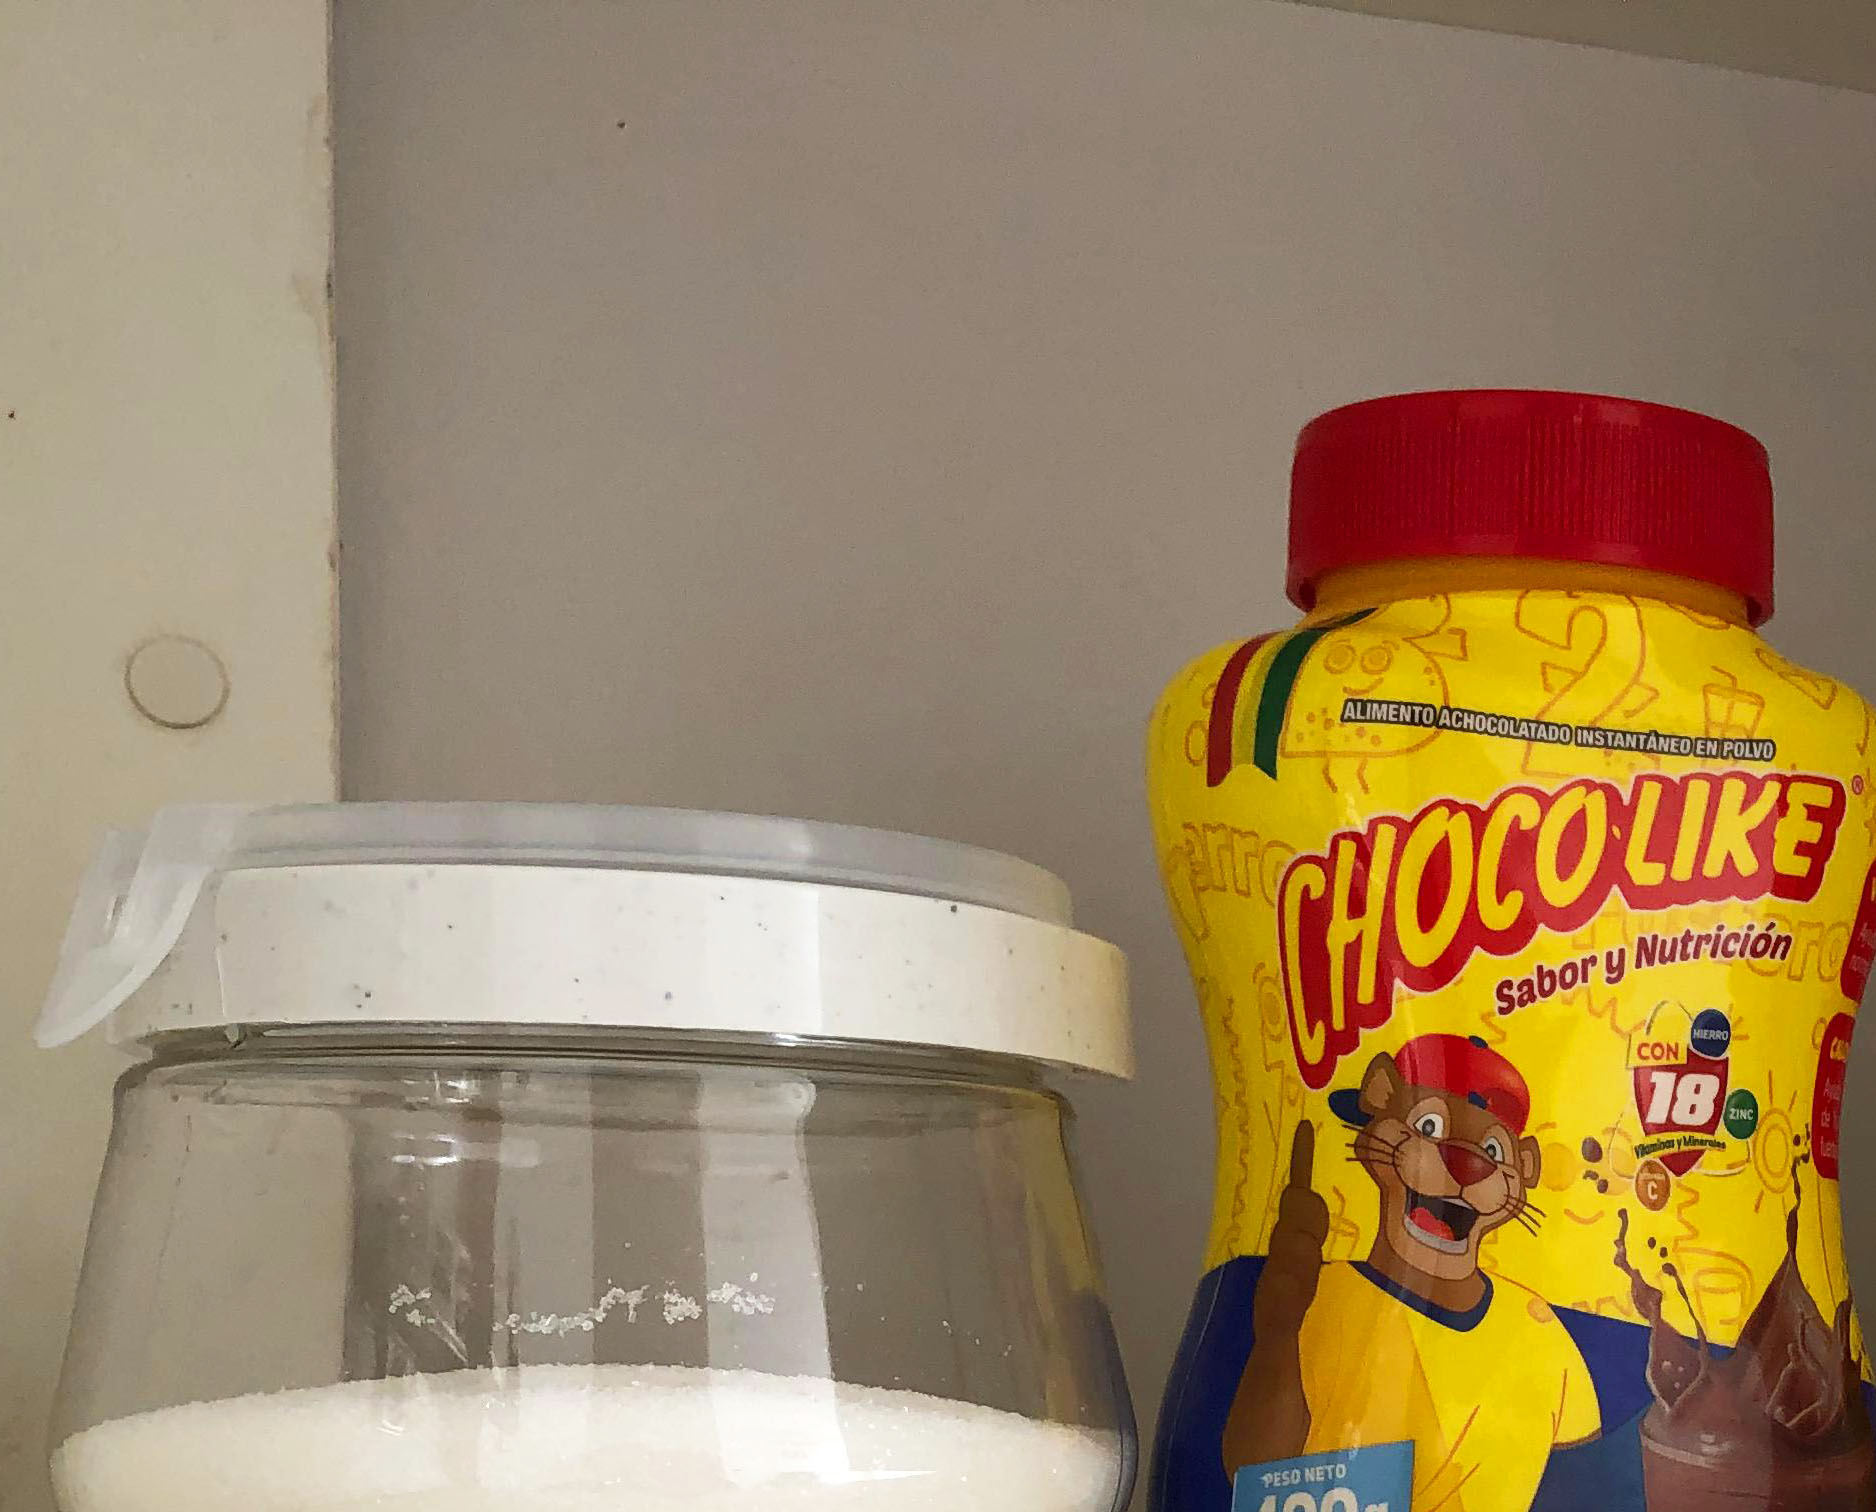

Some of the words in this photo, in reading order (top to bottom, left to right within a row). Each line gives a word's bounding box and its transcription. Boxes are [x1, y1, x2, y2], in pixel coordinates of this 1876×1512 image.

[1343, 700, 1434, 726] ALIMENTO
[1439, 710, 1571, 744] ACHOCOLATADO
[1576, 725, 1691, 755] INSTANTÁNEO
[1696, 740, 1718, 756] EN
[1722, 741, 1774, 761] POLVO
[1495, 954, 1597, 1016] Sabor
[1605, 947, 1625, 985] y
[1633, 921, 1794, 970] Nutrición
[1693, 1028, 1729, 1041] HIERRO
[1636, 1042, 1680, 1060] CON
[1645, 1071, 1720, 1126] 18
[1729, 1107, 1754, 1121] ZINC
[1647, 1181, 1658, 1200] C
[1264, 1468, 1301, 1488] PESO
[1304, 1463, 1347, 1483] NETO
